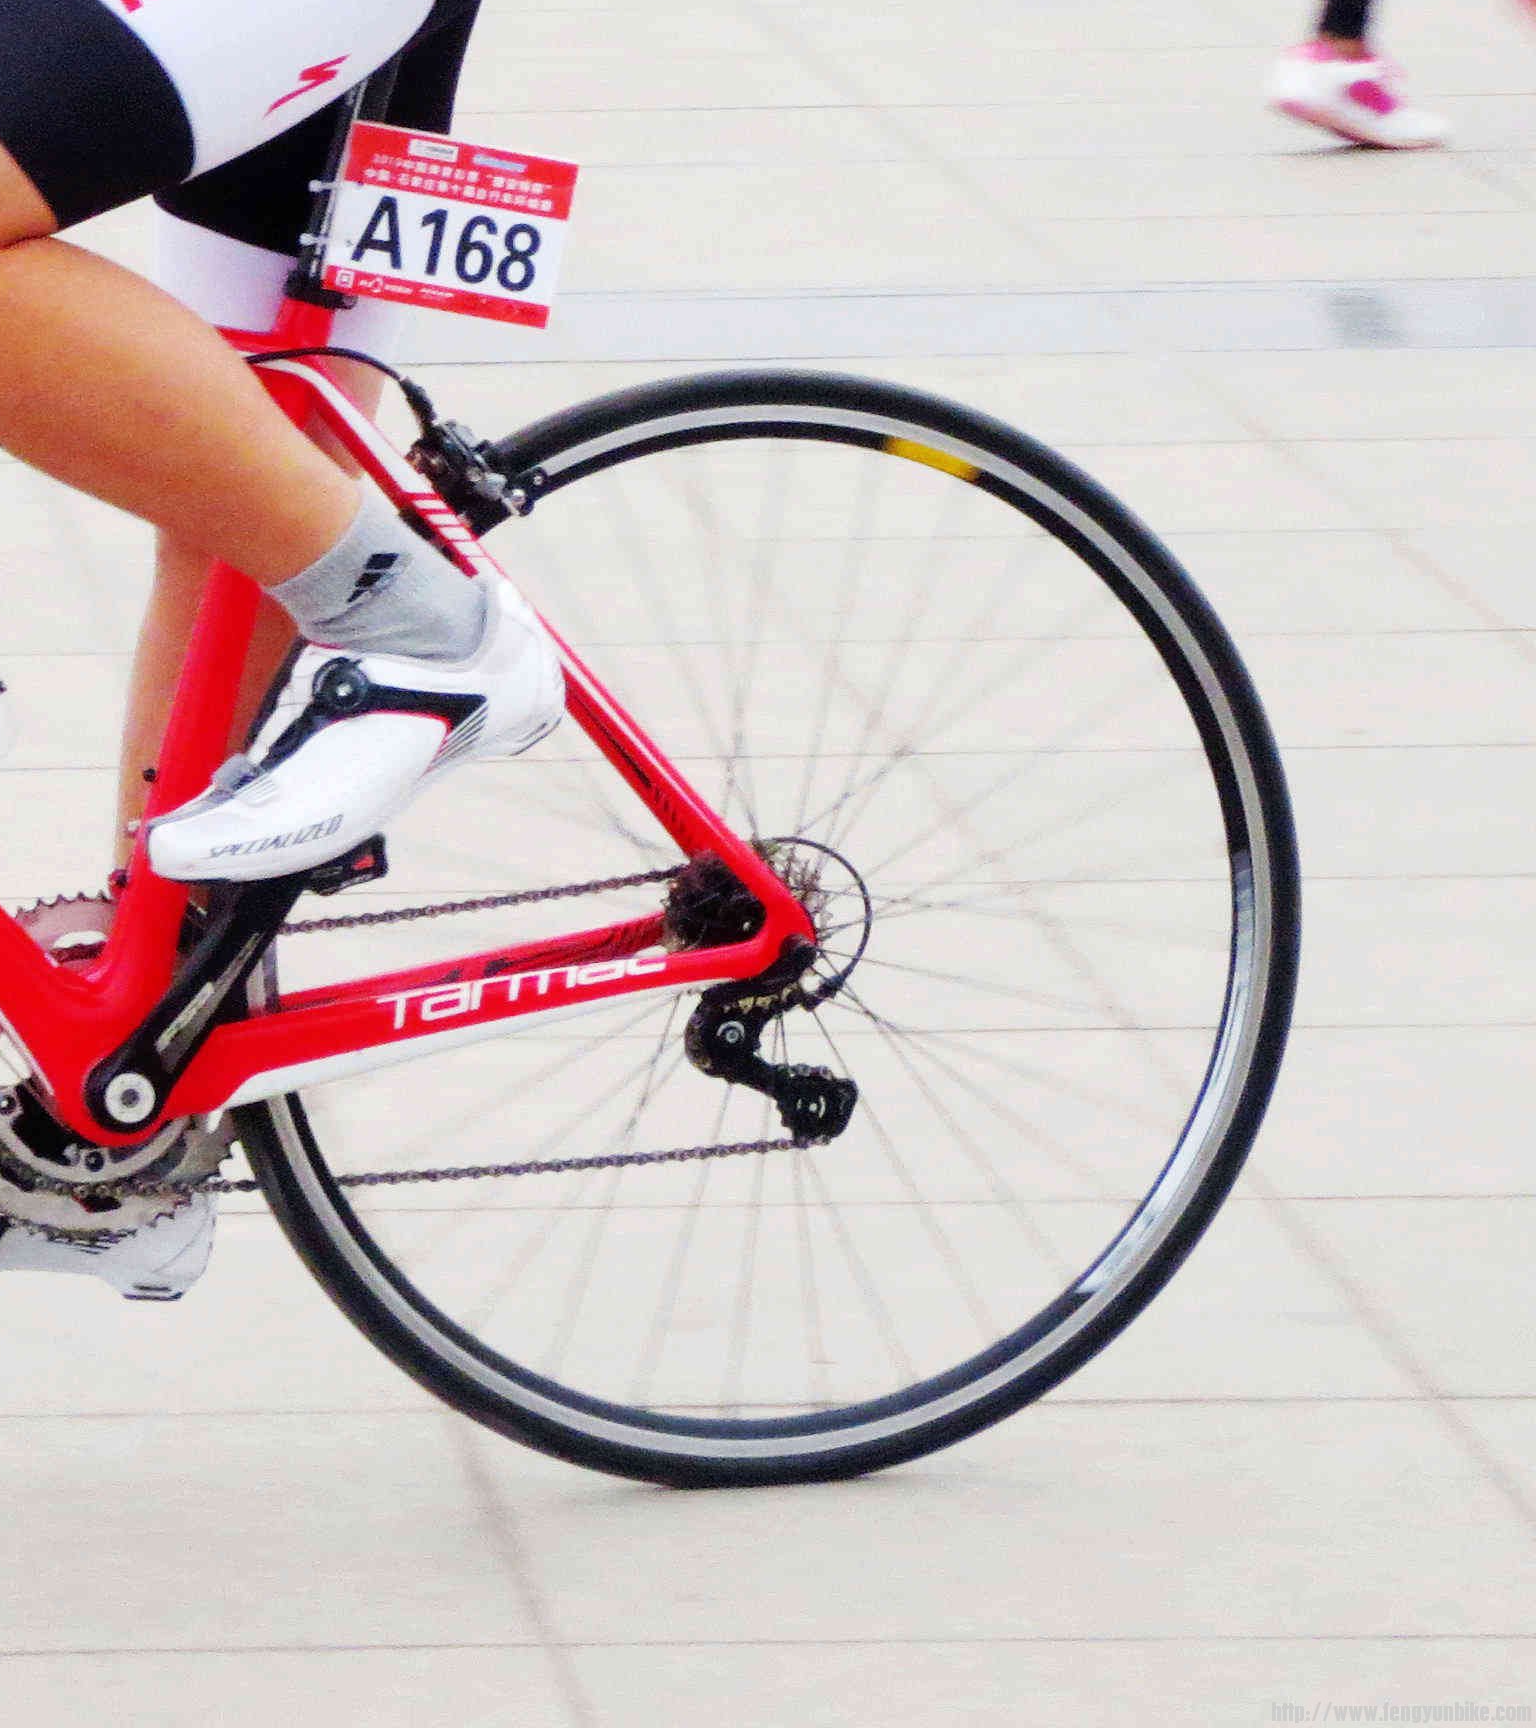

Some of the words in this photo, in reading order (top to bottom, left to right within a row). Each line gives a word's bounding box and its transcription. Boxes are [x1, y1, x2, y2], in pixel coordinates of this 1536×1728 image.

[350, 195, 542, 293] A168
[208, 813, 344, 859] SPECIALIZED
[376, 954, 668, 1030] Tarmac
